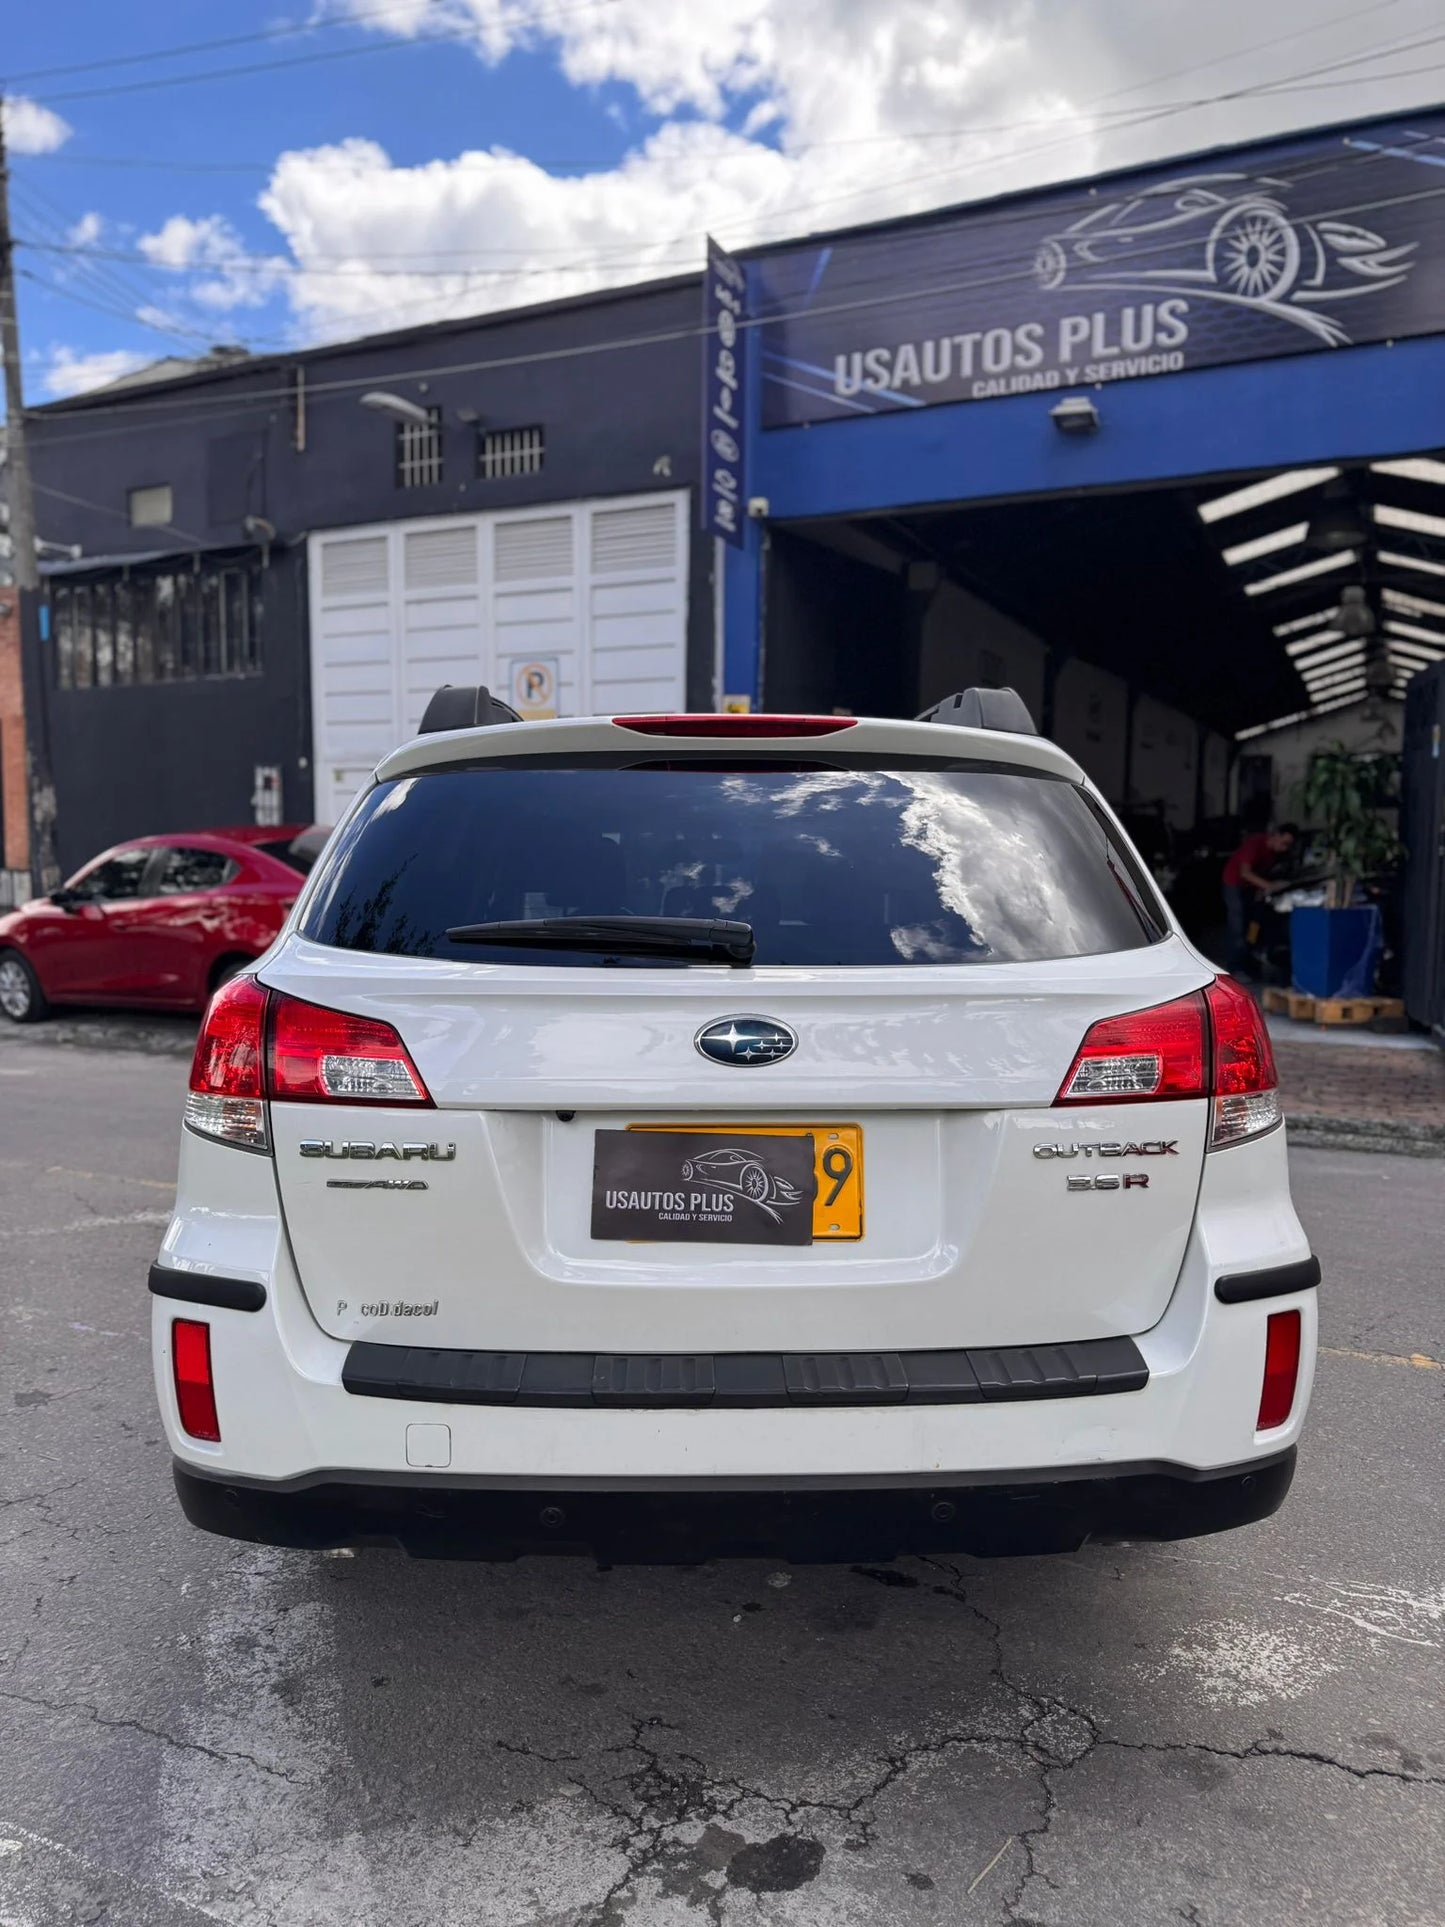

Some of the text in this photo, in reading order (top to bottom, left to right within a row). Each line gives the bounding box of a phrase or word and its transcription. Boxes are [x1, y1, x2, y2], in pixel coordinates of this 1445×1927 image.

[834, 298, 1191, 397] USAUTOS PLUS
[972, 351, 1185, 399] CALIDAD Y SERVICIO
[299, 1138, 456, 1162] SUBARU
[1032, 1139, 1180, 1160] OUTBACK
[822, 1146, 854, 1207] 9
[605, 1190, 734, 1213] USAUTOS PLUS
[658, 1212, 733, 1223] CALIDAD Y SERVICIO
